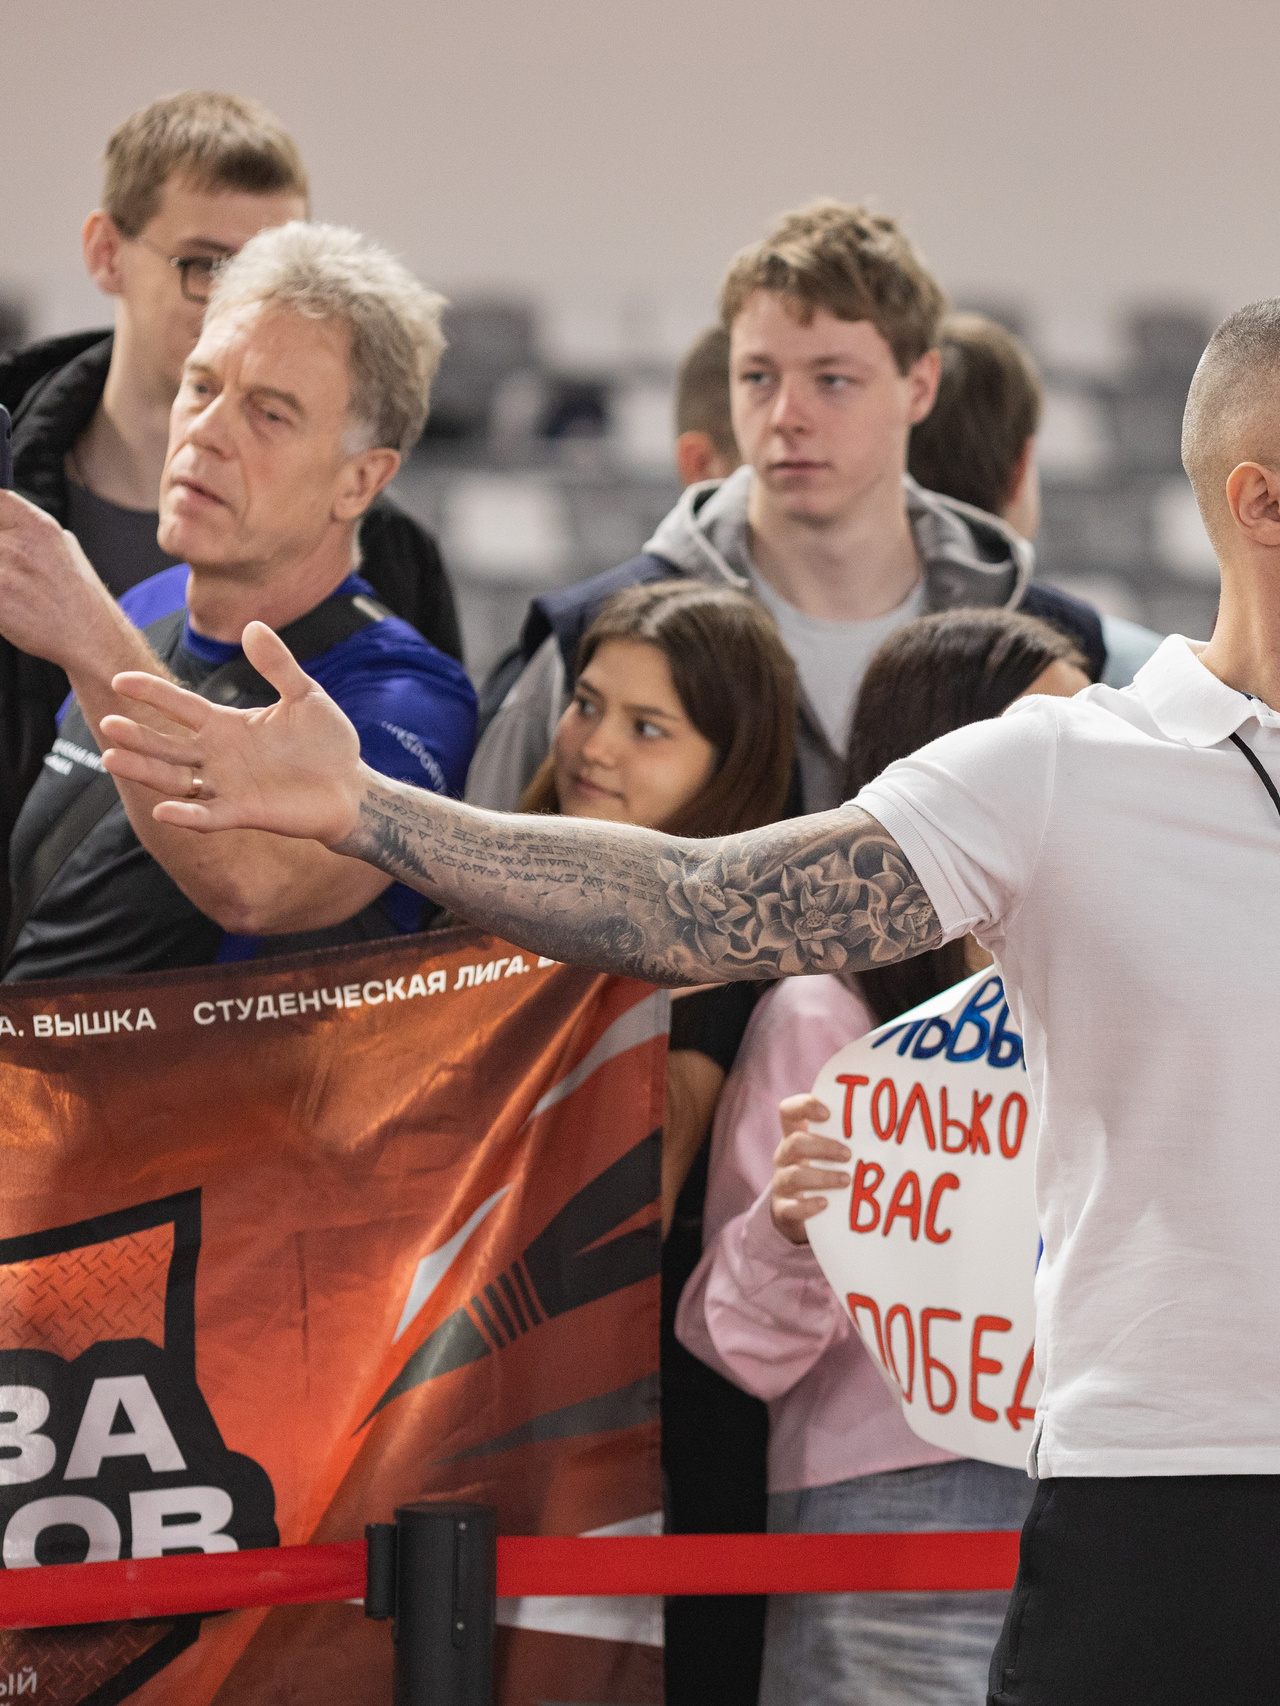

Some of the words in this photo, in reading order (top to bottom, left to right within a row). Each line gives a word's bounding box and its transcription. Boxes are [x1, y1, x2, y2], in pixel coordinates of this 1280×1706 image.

[32, 1007, 157, 1038] ВЫШКА
[193, 969, 448, 1026] СТУДЕНЧЕСКАЯ
[453, 954, 531, 991] ЛИГА.
[835, 1073, 1028, 1160] ТОЛЬКО
[849, 1158, 961, 1244] ВАС
[0, 1374, 188, 1486] ВА
